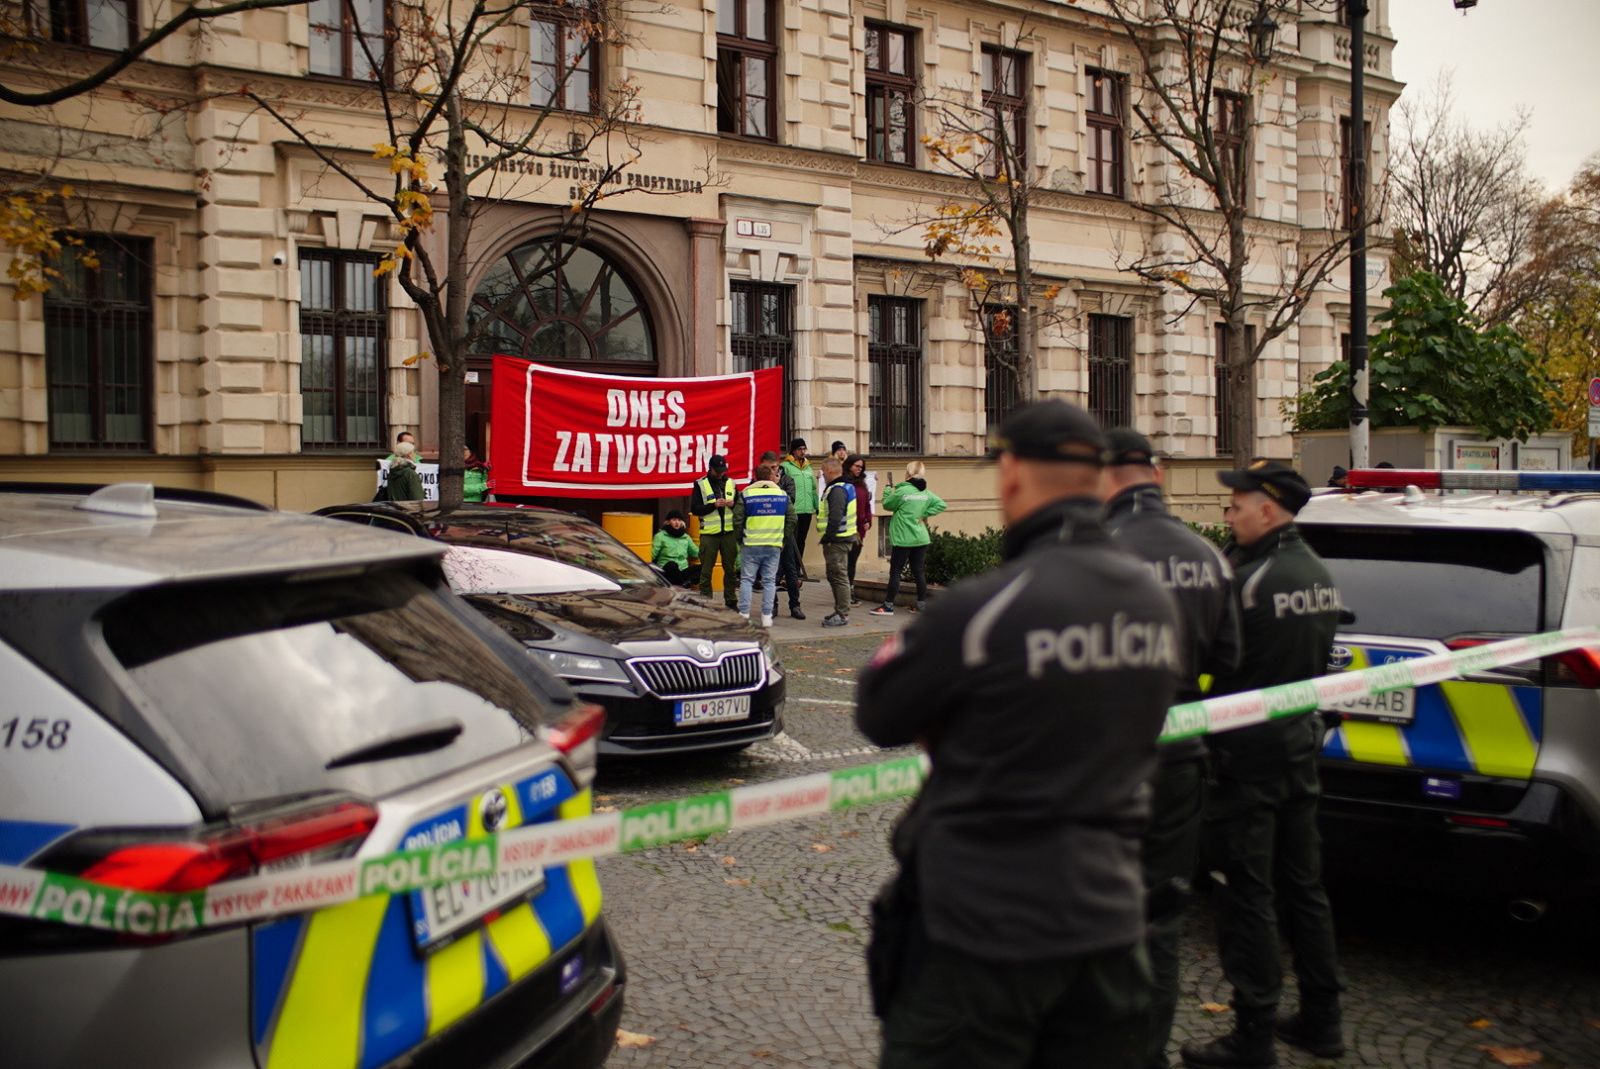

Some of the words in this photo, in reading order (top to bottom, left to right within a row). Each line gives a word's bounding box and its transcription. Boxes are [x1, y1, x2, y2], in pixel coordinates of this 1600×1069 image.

[550, 162, 622, 184] ŽIVOTNÉO
[627, 172, 703, 194] PROSTREDIA
[607, 389, 686, 429] DNES
[553, 426, 729, 474] ZATVORENÉ
[1273, 582, 1342, 618] POLÍCIA
[1026, 611, 1177, 678] POLÍCIA
[683, 703, 700, 719] BL
[709, 698, 749, 716] 387VU
[2, 716, 71, 750] 158
[35, 884, 198, 935] POLÍCIA
[212, 889, 267, 917] VSTUP
[272, 869, 357, 908] ZAKÁZANÝ
[364, 844, 492, 894] POLÍCIA
[624, 798, 727, 844] POLÍCIA
[834, 763, 920, 804] POLÍCIA
